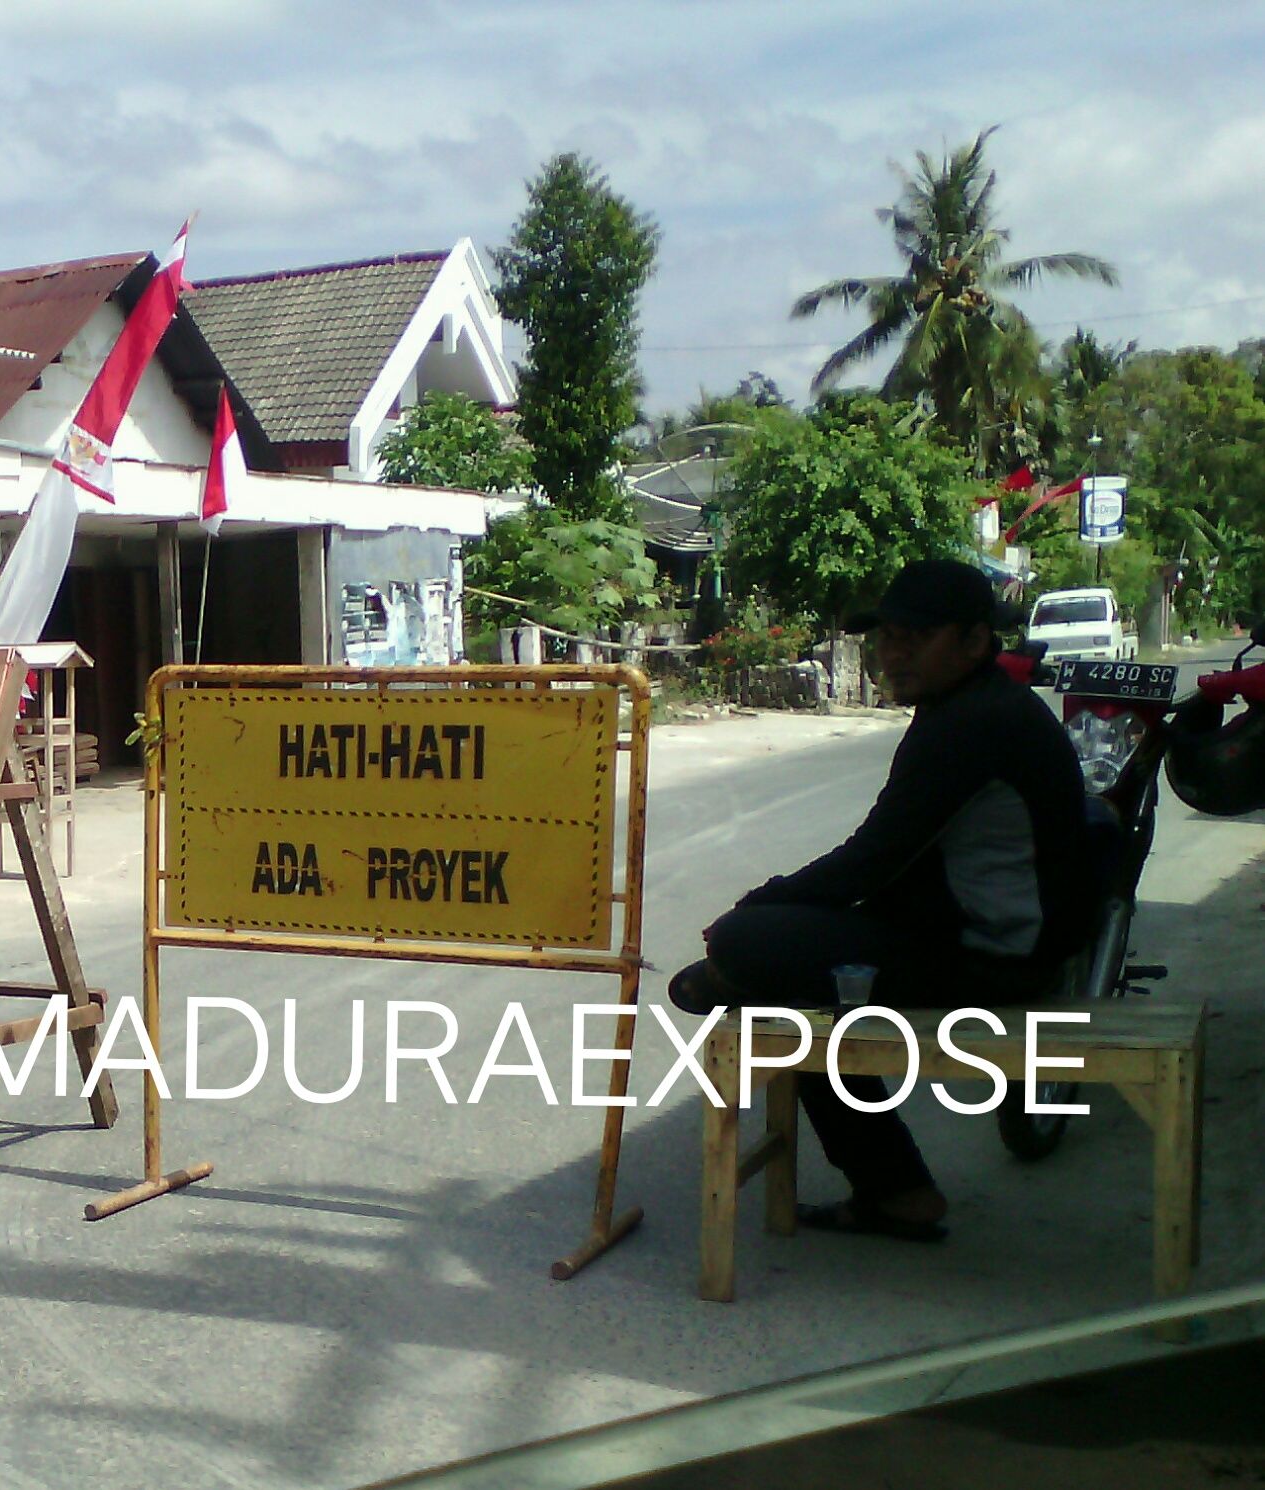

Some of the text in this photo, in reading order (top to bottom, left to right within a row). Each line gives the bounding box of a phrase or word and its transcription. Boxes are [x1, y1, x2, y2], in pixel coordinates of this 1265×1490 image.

[1063, 663, 1172, 683] W 4280 SC
[279, 724, 485, 780] HATI-HATI
[252, 842, 510, 904] ADA PROYEK
